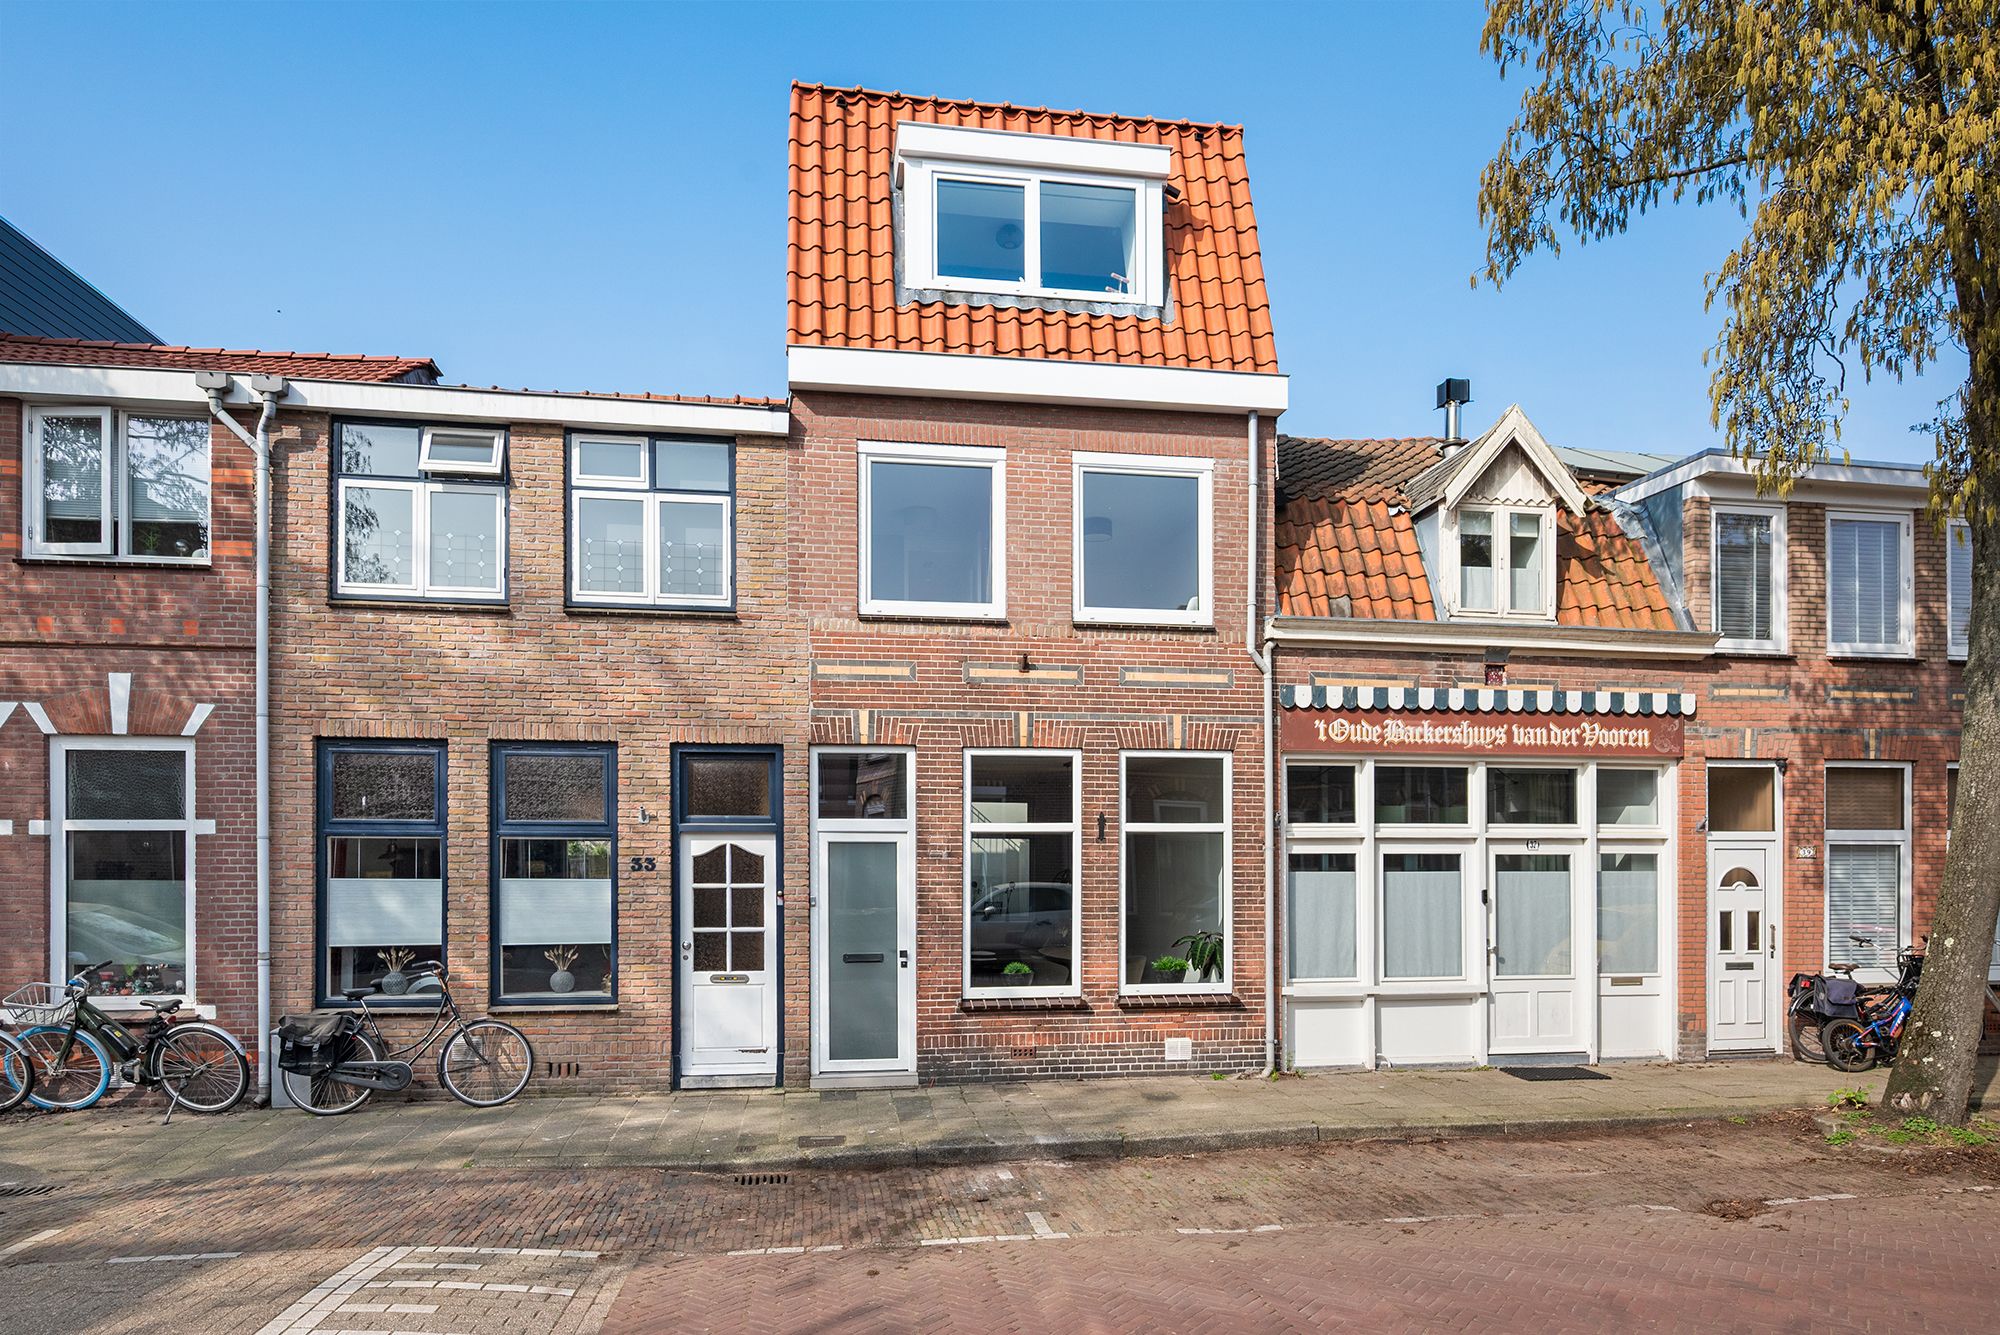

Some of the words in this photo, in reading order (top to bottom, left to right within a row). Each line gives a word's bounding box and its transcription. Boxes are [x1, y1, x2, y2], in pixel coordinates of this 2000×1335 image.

[1328, 718, 1382, 744] Oude
[1383, 718, 1508, 749] Backershuys
[1512, 723, 1548, 747] van
[1549, 721, 1580, 748] der
[1580, 718, 1650, 750] Vooren
[630, 857, 657, 872] 33
